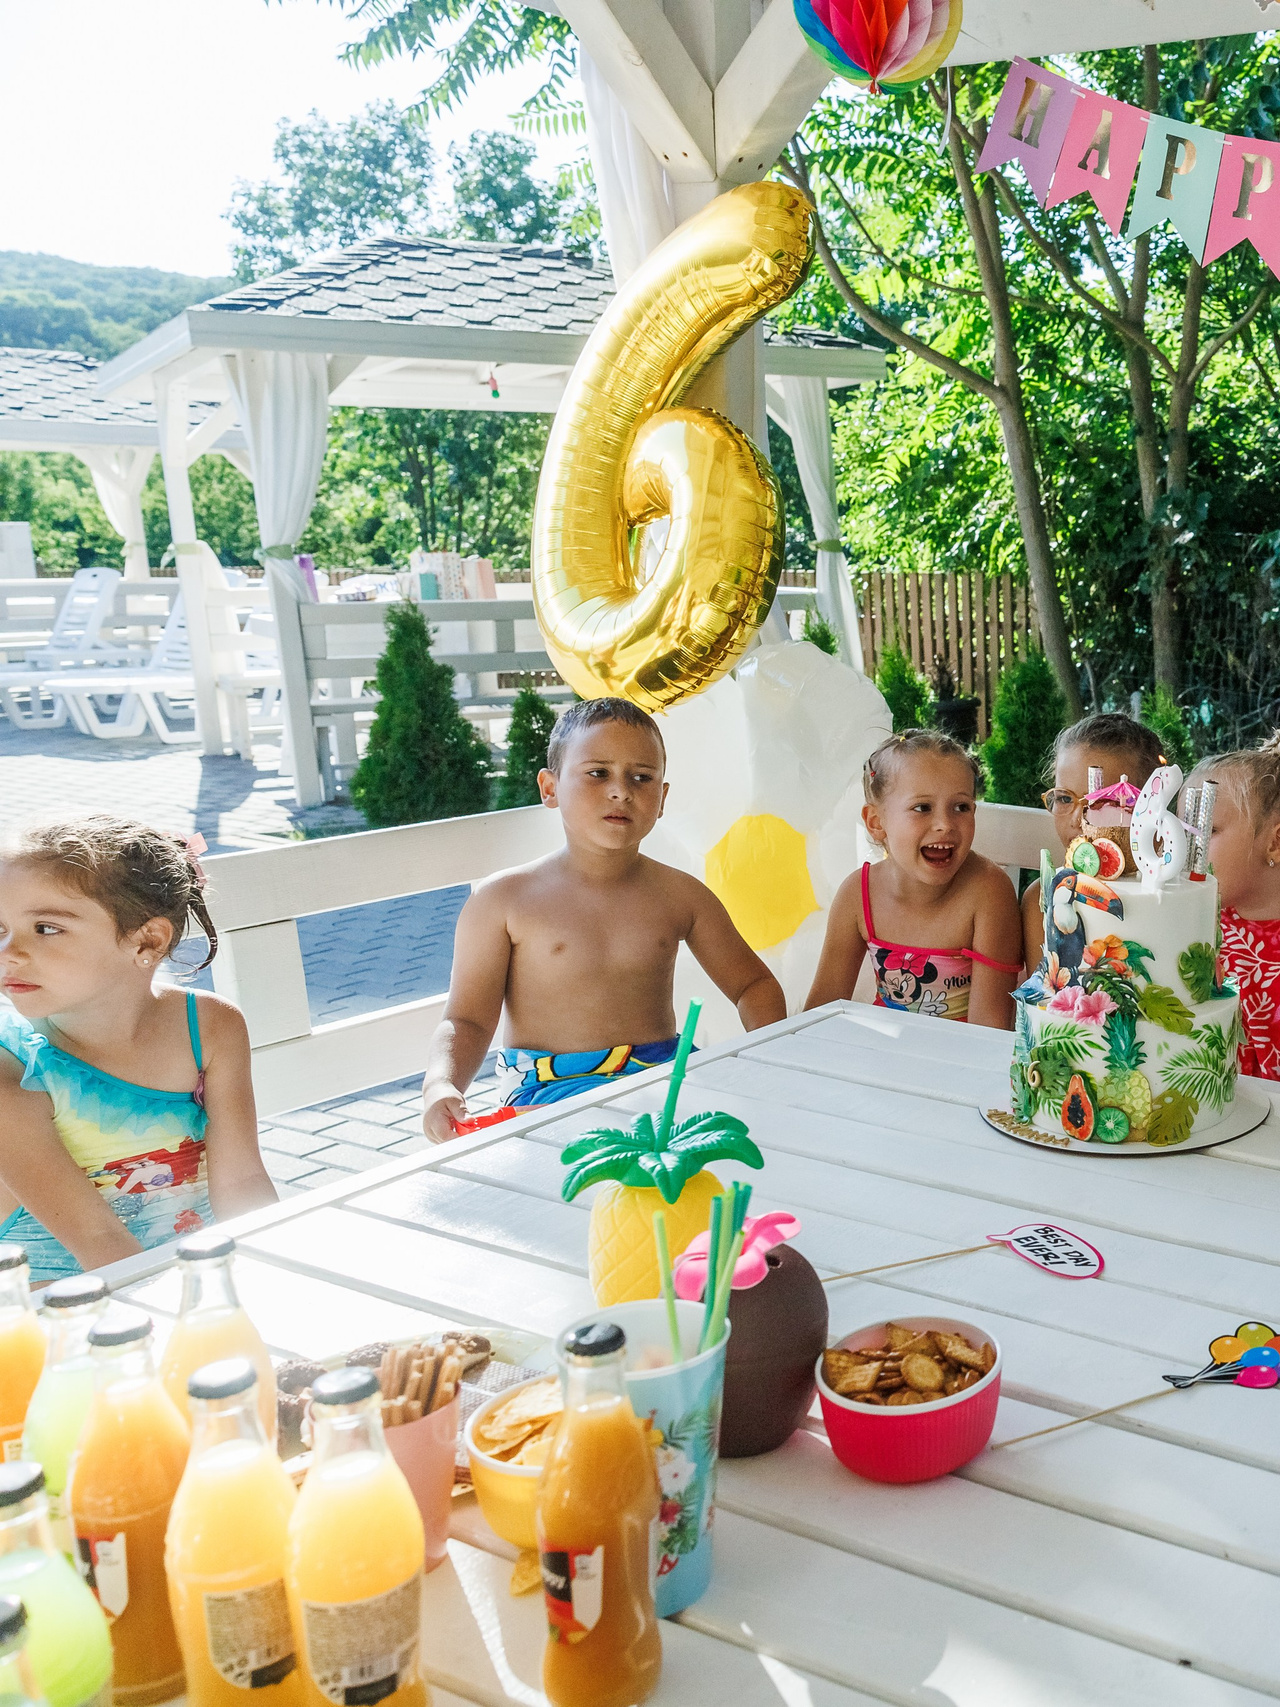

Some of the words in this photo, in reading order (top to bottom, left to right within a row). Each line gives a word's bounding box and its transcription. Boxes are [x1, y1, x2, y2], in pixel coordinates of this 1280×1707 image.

[531, 180, 818, 717] 6
[1012, 1235, 1068, 1266] EVER!
[1033, 1226, 1074, 1248] BEST
[1062, 1250, 1097, 1267] DAY
